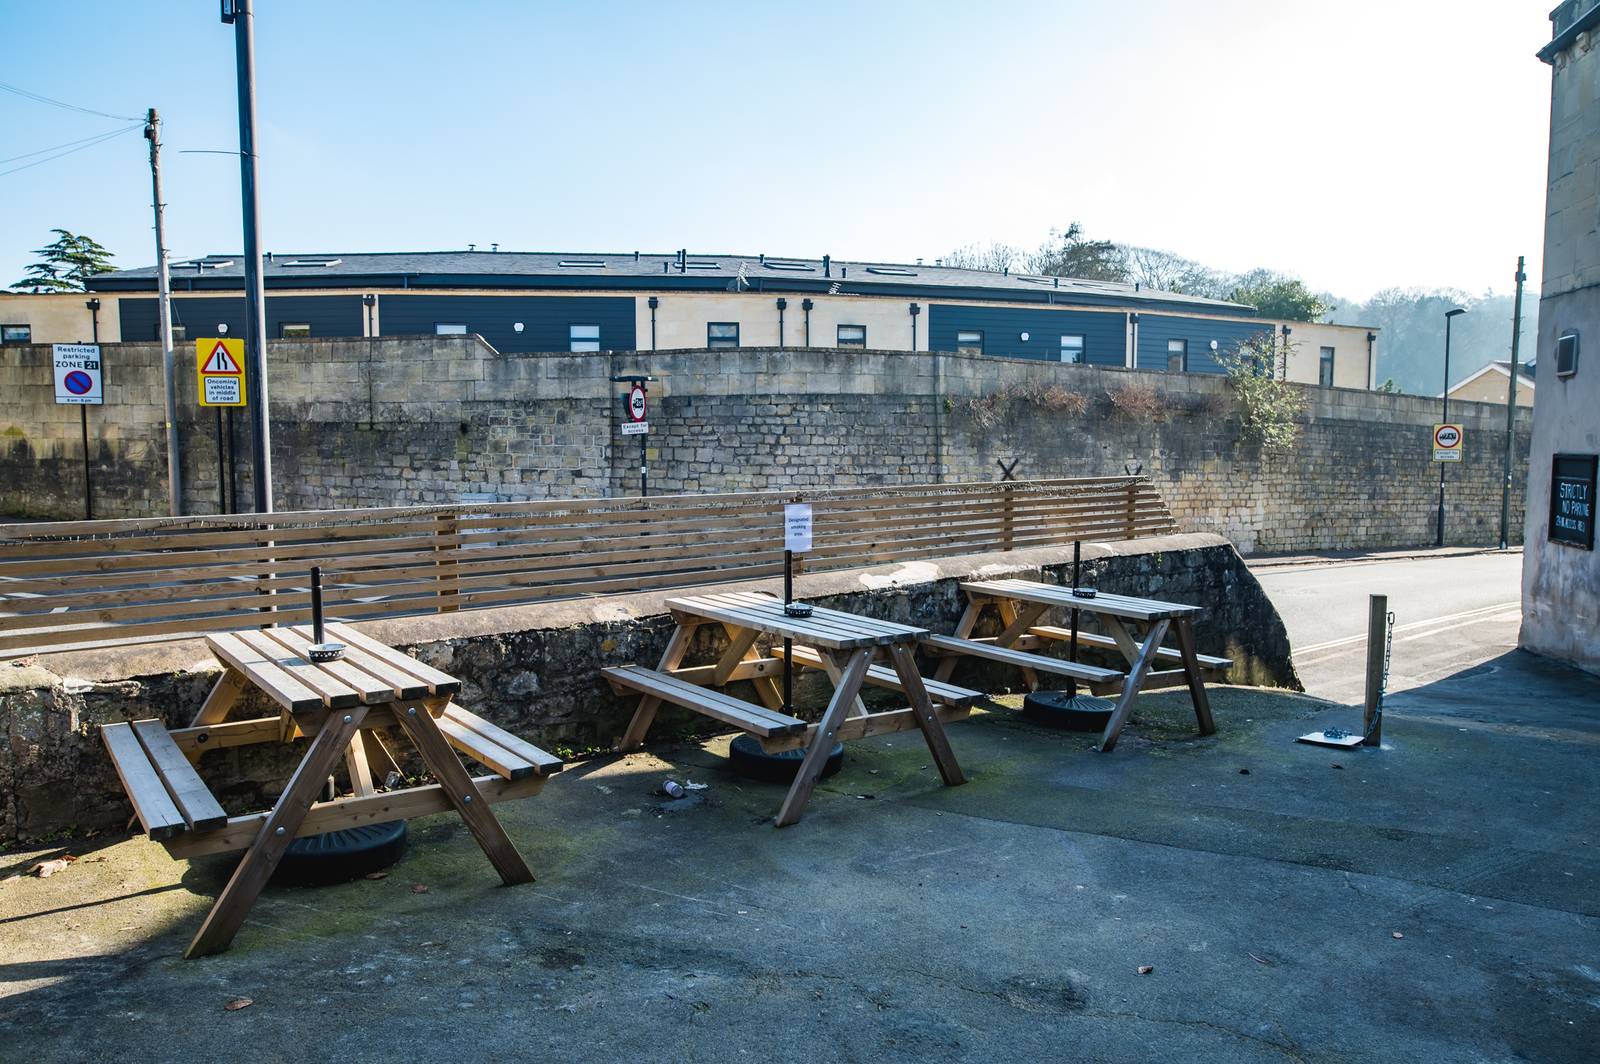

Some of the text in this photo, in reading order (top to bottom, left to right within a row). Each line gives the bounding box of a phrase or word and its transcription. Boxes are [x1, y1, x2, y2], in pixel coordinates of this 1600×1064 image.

[57, 346, 96, 354] Restricted
[55, 360, 97, 369] ZONE 21
[1559, 482, 1588, 500] STRICTLY
[1562, 500, 1570, 514] NO
